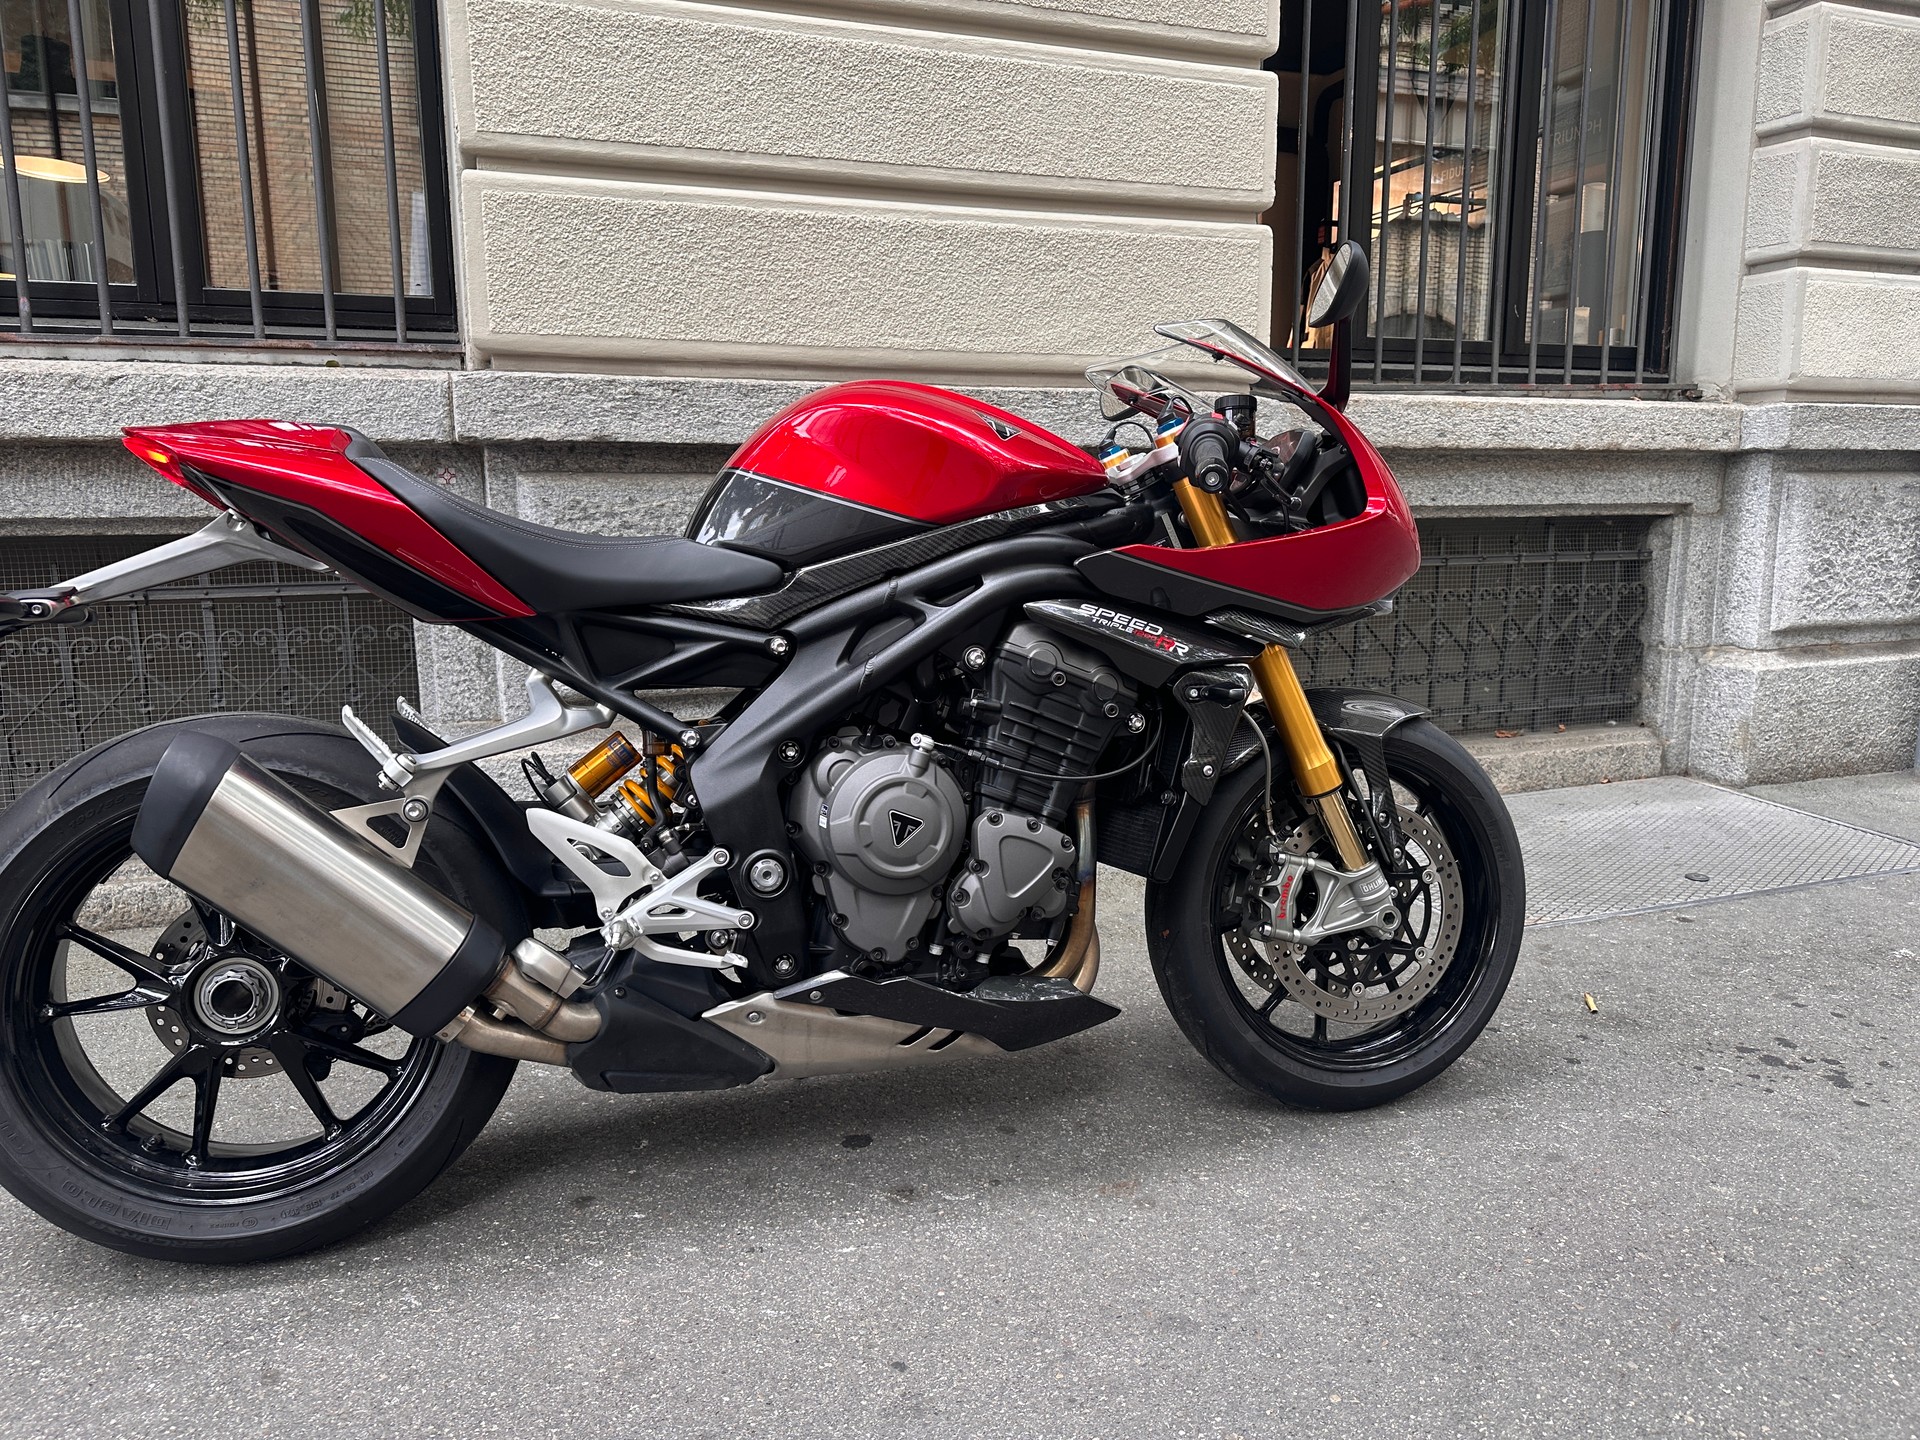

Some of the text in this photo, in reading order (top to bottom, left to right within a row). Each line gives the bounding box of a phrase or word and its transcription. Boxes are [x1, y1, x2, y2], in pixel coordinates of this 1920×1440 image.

[1549, 118, 1602, 145] RIUPH
[1080, 603, 1164, 636] SPEED
[1091, 616, 1134, 634] TRIPLE
[1276, 875, 1294, 920] brembo
[62, 1180, 172, 1231] DIABLO
